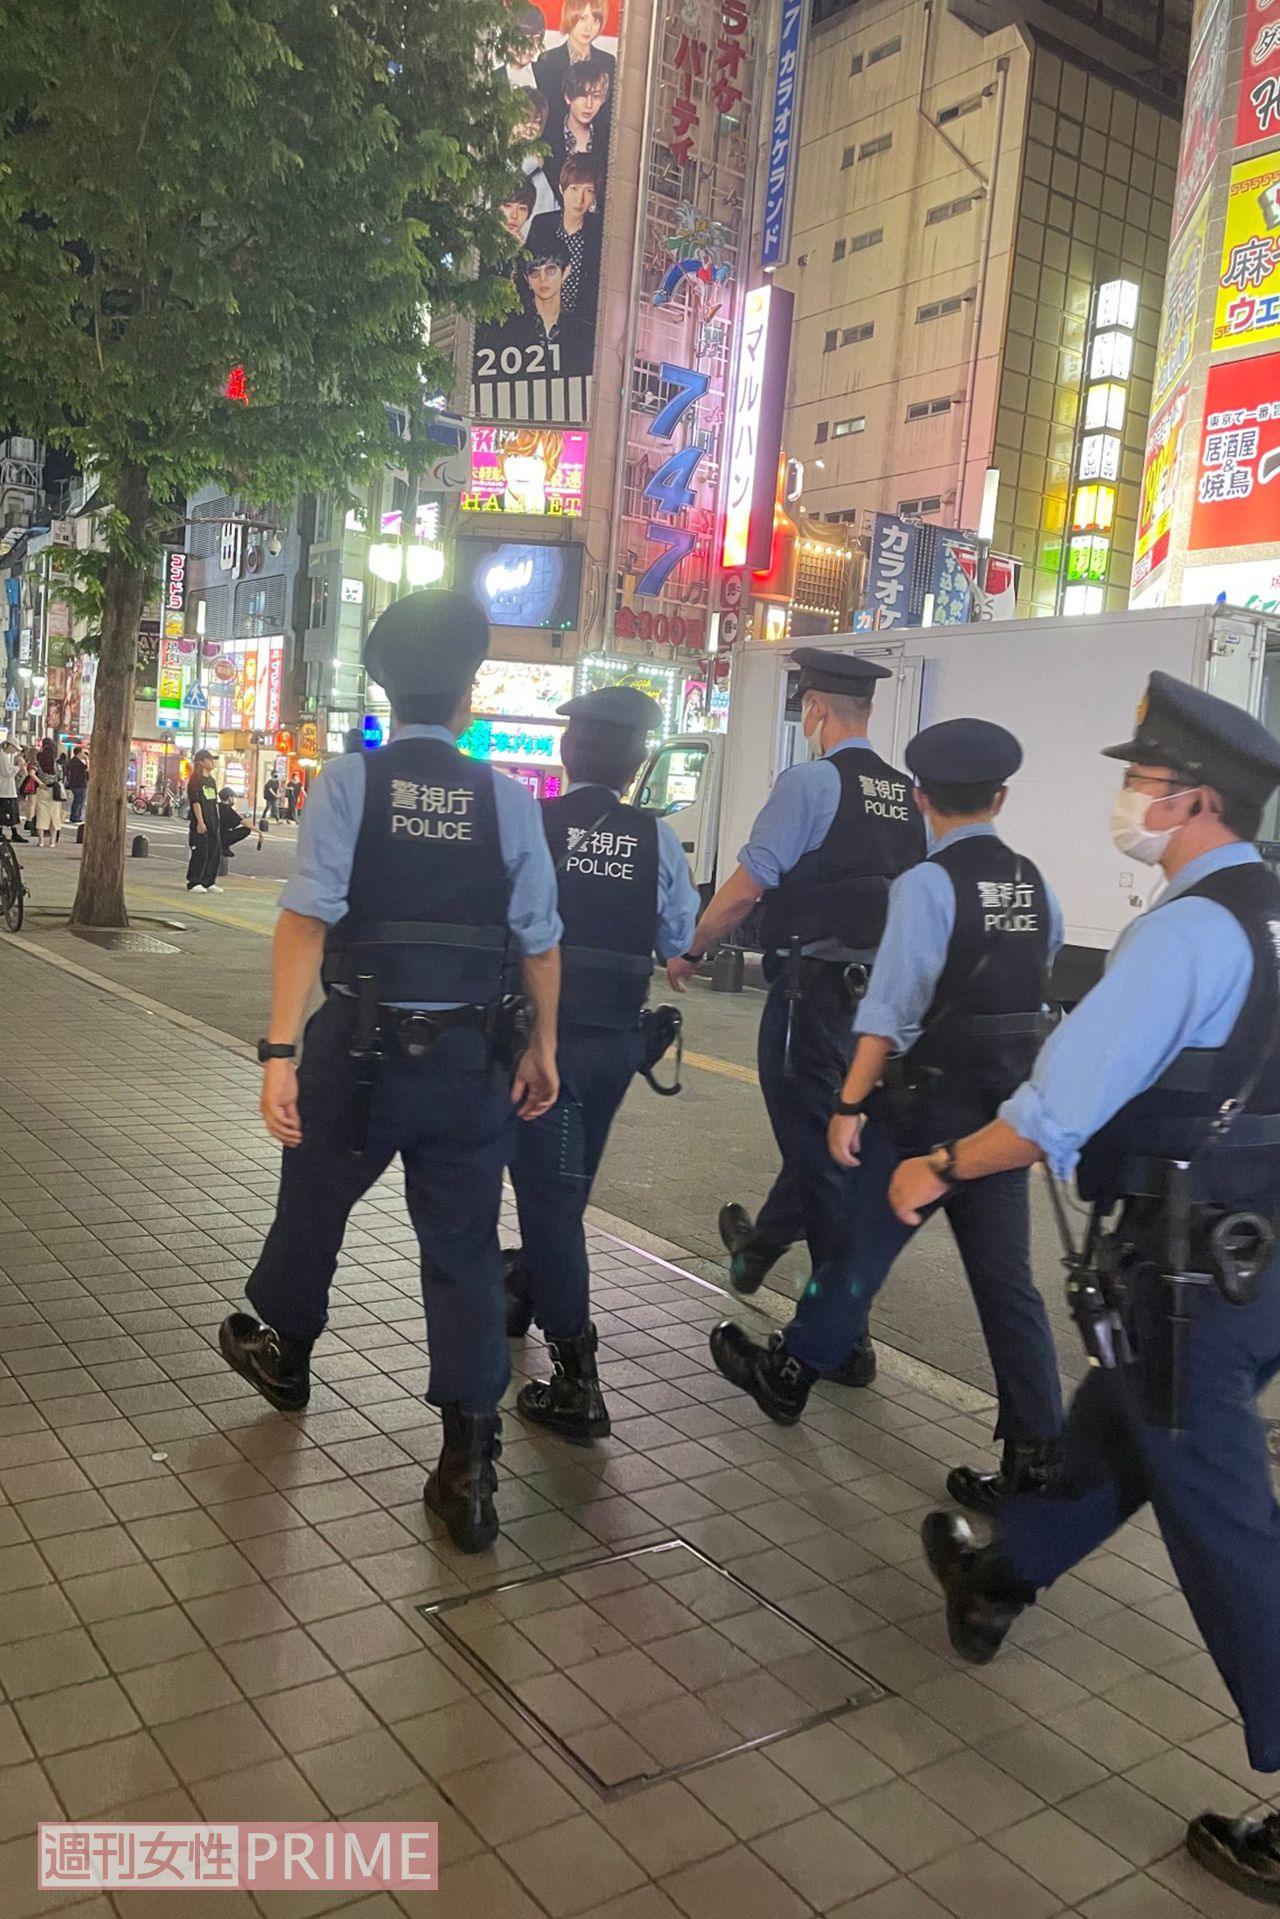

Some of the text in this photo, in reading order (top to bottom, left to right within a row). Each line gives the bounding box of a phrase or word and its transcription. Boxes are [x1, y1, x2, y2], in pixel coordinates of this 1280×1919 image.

[763, 50, 797, 255] カラオケランド
[1222, 237, 1280, 290] 麻
[476, 344, 561, 377] 2021
[732, 324, 765, 509] マルハン
[1206, 430, 1257, 462] 居酒屋
[1223, 458, 1235, 473] &
[1201, 469, 1251, 500] 焼鳥
[461, 491, 582, 517] HAMET
[874, 525, 910, 631] カラオケ
[390, 779, 475, 815] 警視庁
[858, 775, 906, 802] 警視庁
[864, 800, 909, 821] POLICE
[391, 815, 473, 841] POLICE
[566, 827, 638, 858] 警視庁
[566, 856, 635, 880] POLICE
